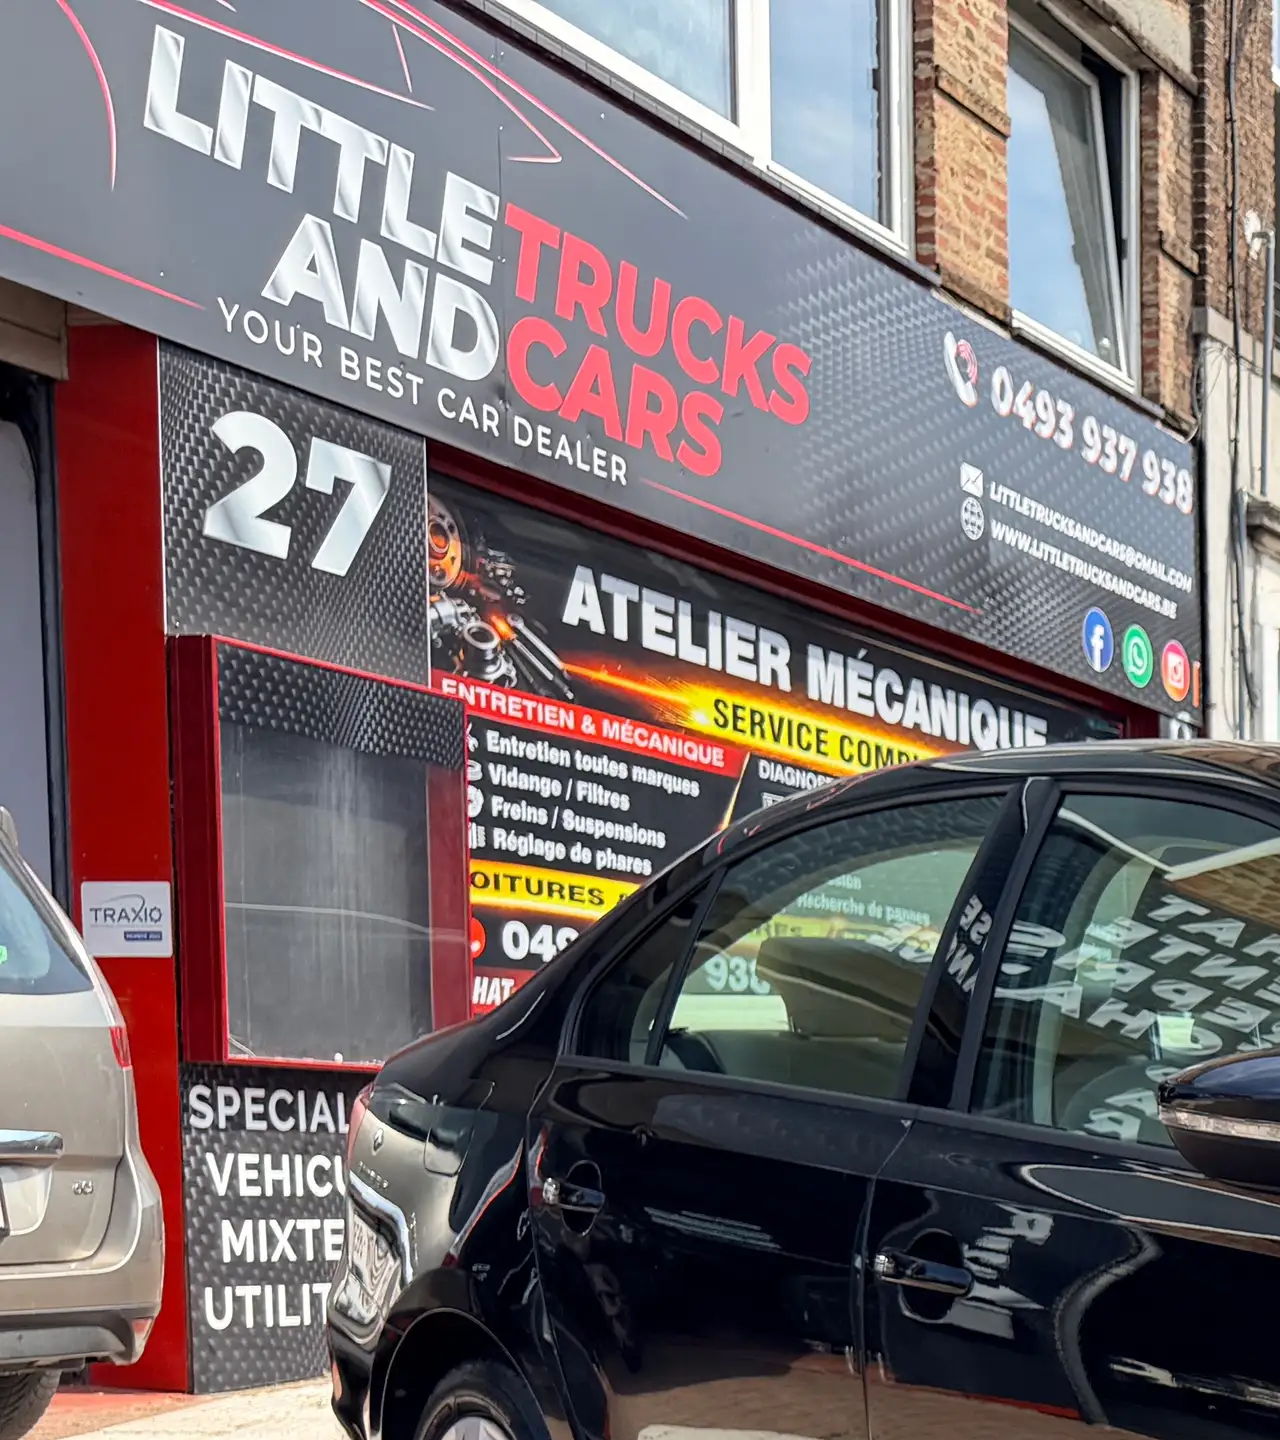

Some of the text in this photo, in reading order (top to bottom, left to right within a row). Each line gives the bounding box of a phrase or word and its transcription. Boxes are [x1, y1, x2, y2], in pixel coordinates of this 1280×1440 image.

[143, 24, 812, 425] LITTLE TRUCKS
[217, 297, 628, 486] YOUR BEST CAR DEALER
[261, 213, 724, 477] AND CARS
[991, 365, 1194, 514] 0493 937 938
[203, 410, 392, 577] 27
[989, 481, 1192, 594] LITTLETRUCKSANDCARS@GMAIL.COM
[990, 518, 1177, 620] WWW.LITTLETRUCKSANDCARS.BE
[561, 564, 1047, 752] ATELIER MÉCANIQUE
[442, 677, 725, 768] ENTRETIEN & MÉCANIQUE
[486, 729, 701, 799] Entretien toutes marques
[713, 699, 920, 769] SERVICE COM
[488, 762, 631, 812] Vidange / Filtres
[491, 795, 666, 850] Freins / Suspensions
[493, 827, 653, 876] Réglage de phares
[89, 905, 163, 924] TRAXIO
[221, 1219, 345, 1263] MIXTE
